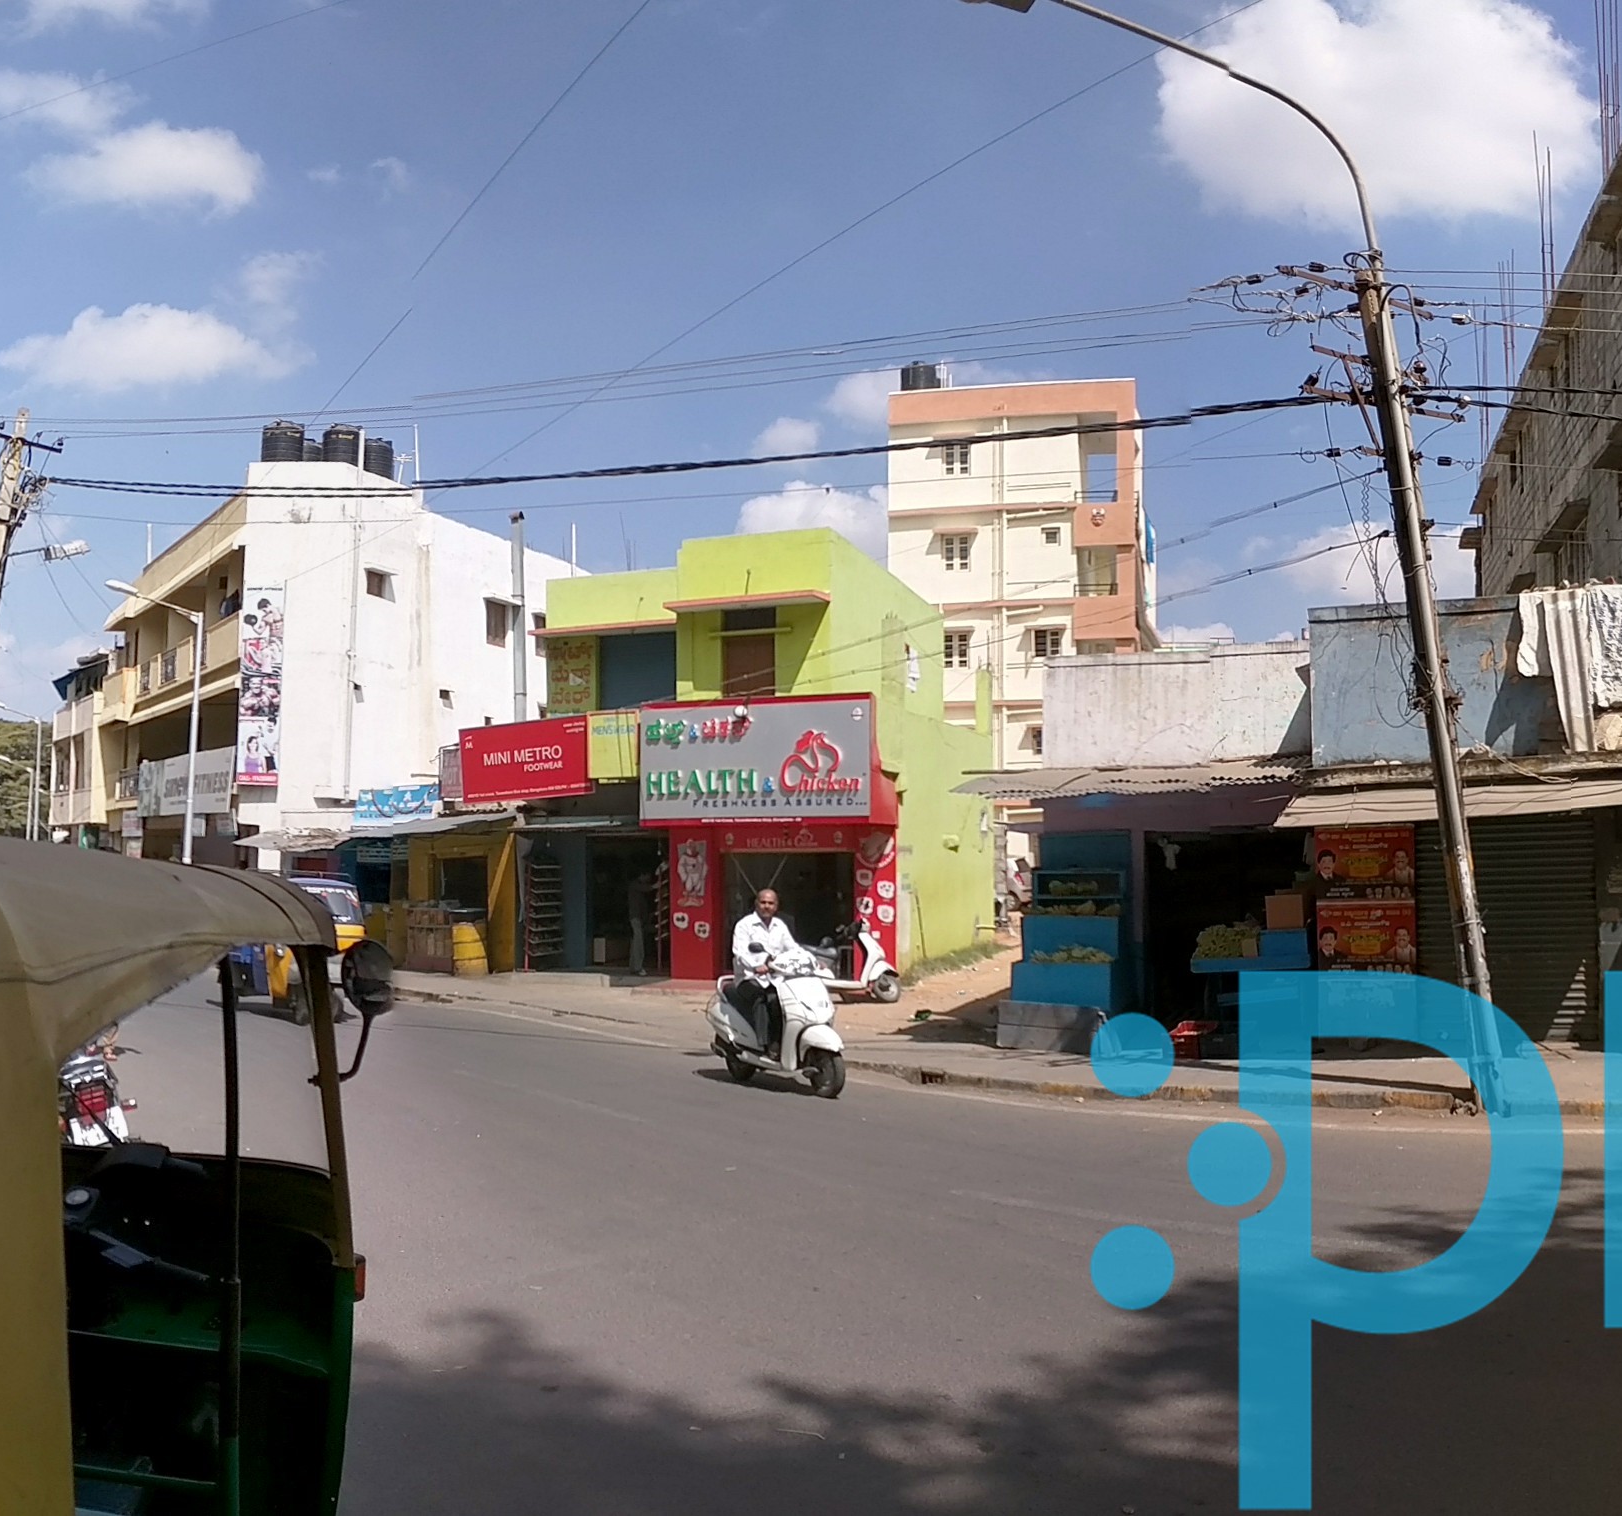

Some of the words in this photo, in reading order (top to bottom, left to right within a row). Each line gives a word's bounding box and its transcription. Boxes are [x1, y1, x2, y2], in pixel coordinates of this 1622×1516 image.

[483, 752, 511, 766] MINI
[514, 745, 562, 763] METRO
[524, 761, 563, 772] FOOTWEAR
[646, 768, 759, 798] HEALTH
[763, 777, 774, 793] &
[781, 756, 861, 793] Chicken
[693, 799, 777, 808] FRESHNESS
